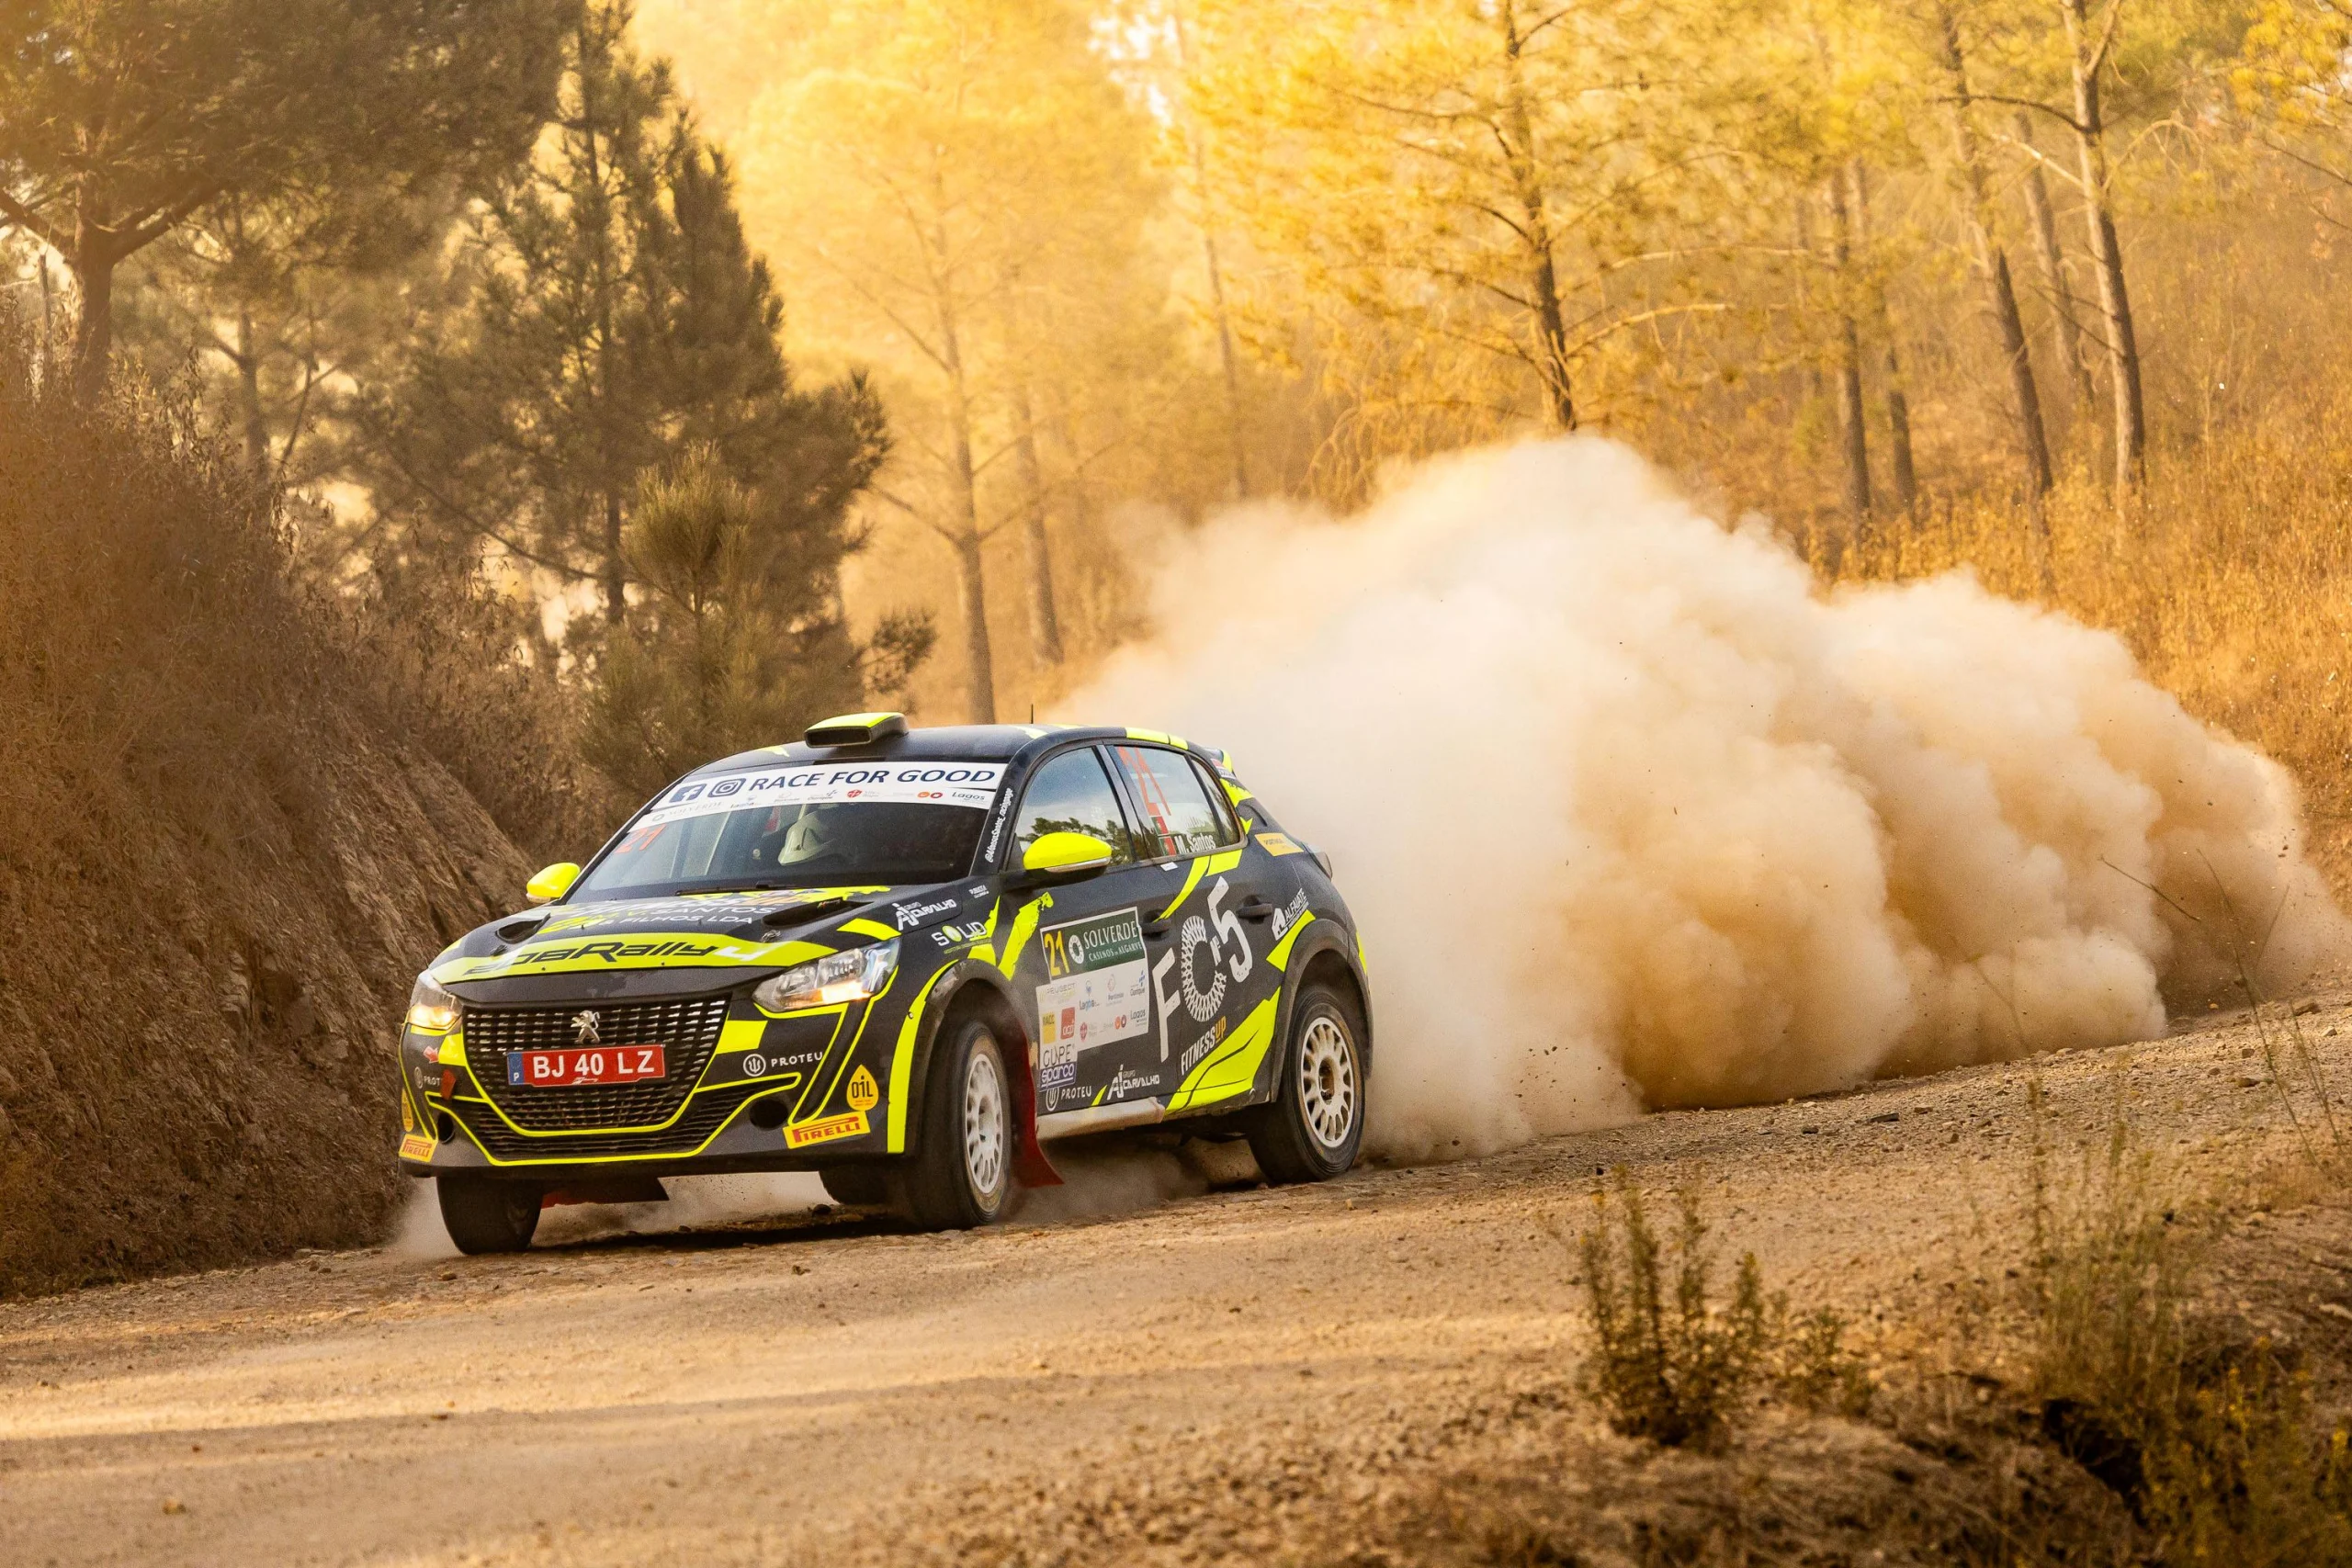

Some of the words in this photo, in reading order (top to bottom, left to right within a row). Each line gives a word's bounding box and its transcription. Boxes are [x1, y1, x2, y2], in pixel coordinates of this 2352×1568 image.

[748, 773, 825, 792] RACE
[829, 770, 889, 785] FOR
[897, 769, 996, 783] GOOD
[952, 791, 986, 802] Lagos
[1174, 834, 1190, 854] M.
[1186, 832, 1216, 852] Santos
[619, 915, 702, 924] FILHOS
[707, 915, 753, 924] LDA
[650, 906, 777, 915] SANTOS
[1044, 930, 1070, 976] 21
[1083, 920, 1138, 950] SOLVERDE
[1089, 949, 1114, 962] CASINOS
[1118, 942, 1142, 955] ALGARVE
[532, 1055, 565, 1079] BJ
[574, 1053, 604, 1076] 40
[616, 1050, 655, 1074] LZ
[770, 1051, 823, 1067] PROTEU
[424, 1076, 441, 1086] PROT
[513, 1072, 520, 1082] P
[1042, 1063, 1075, 1083] sparco
[1060, 1086, 1092, 1100] PROTEU
[792, 1116, 861, 1143] PIRELLI
